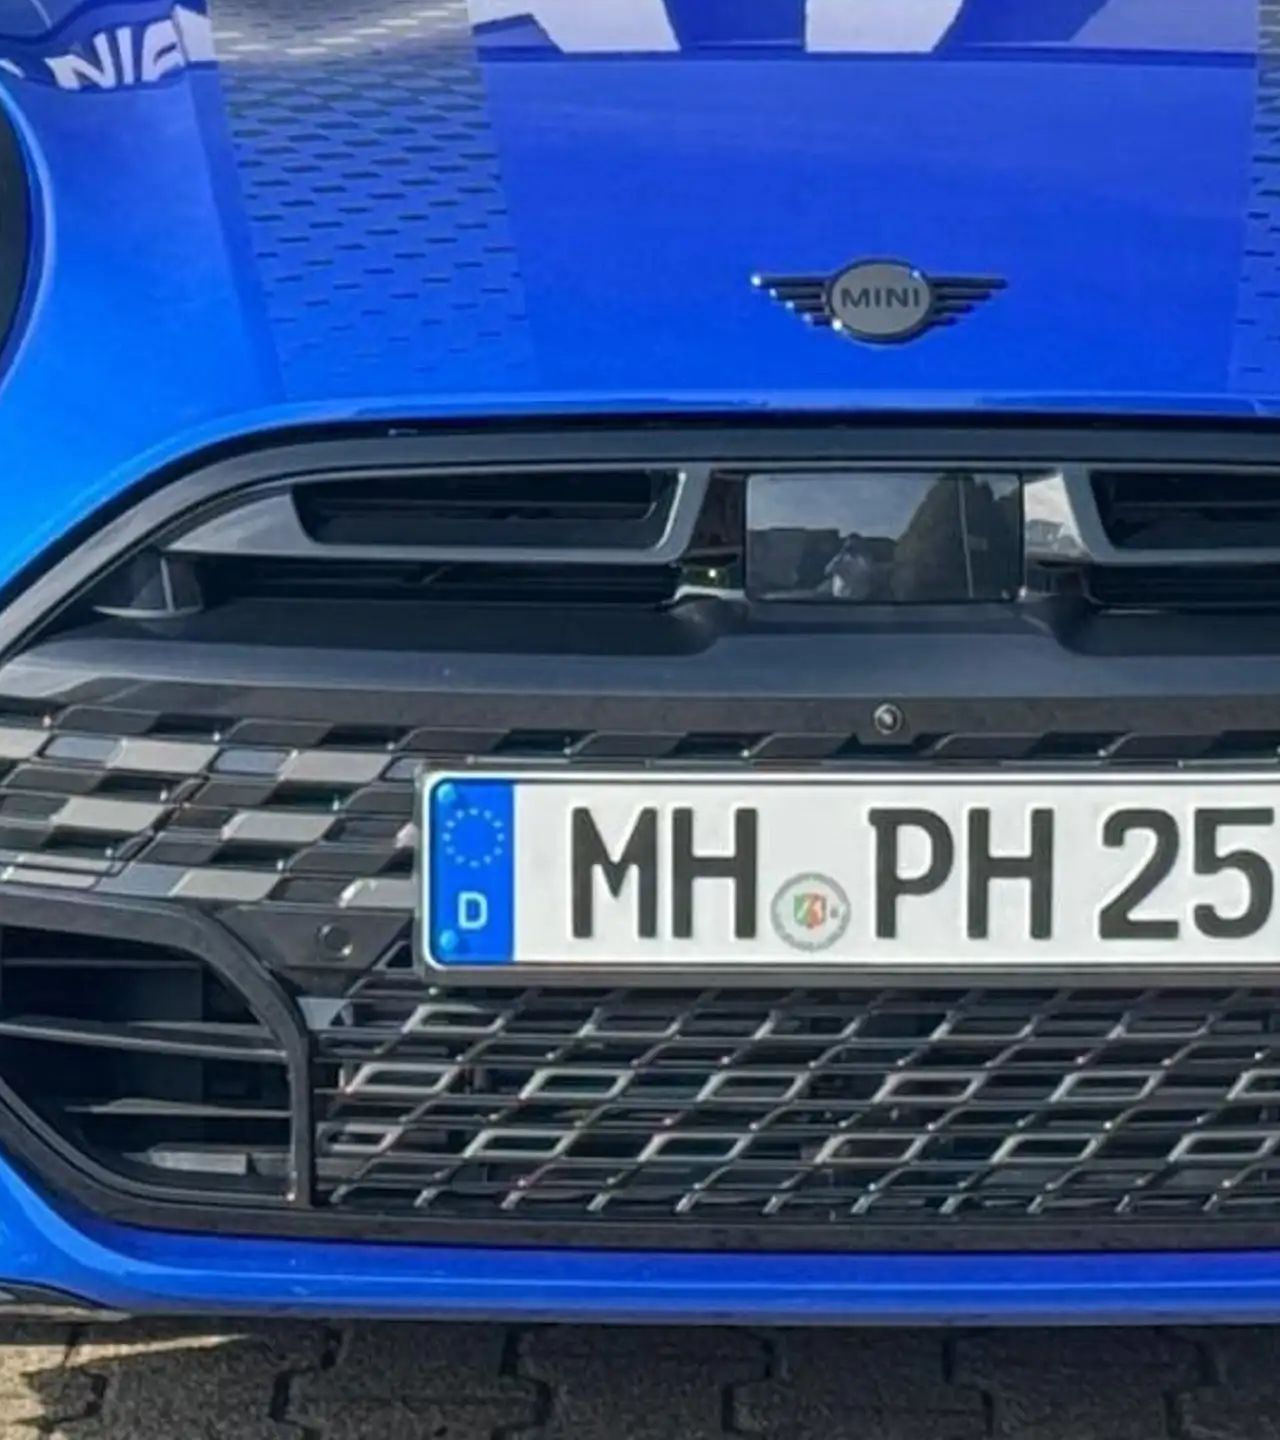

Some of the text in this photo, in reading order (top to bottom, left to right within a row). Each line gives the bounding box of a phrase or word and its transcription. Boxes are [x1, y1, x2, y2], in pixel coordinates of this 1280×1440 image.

[841, 287, 921, 308] MINI
[570, 806, 757, 939] MH
[868, 807, 1054, 940] PH
[1097, 807, 1276, 940] 25
[458, 891, 488, 930] D
